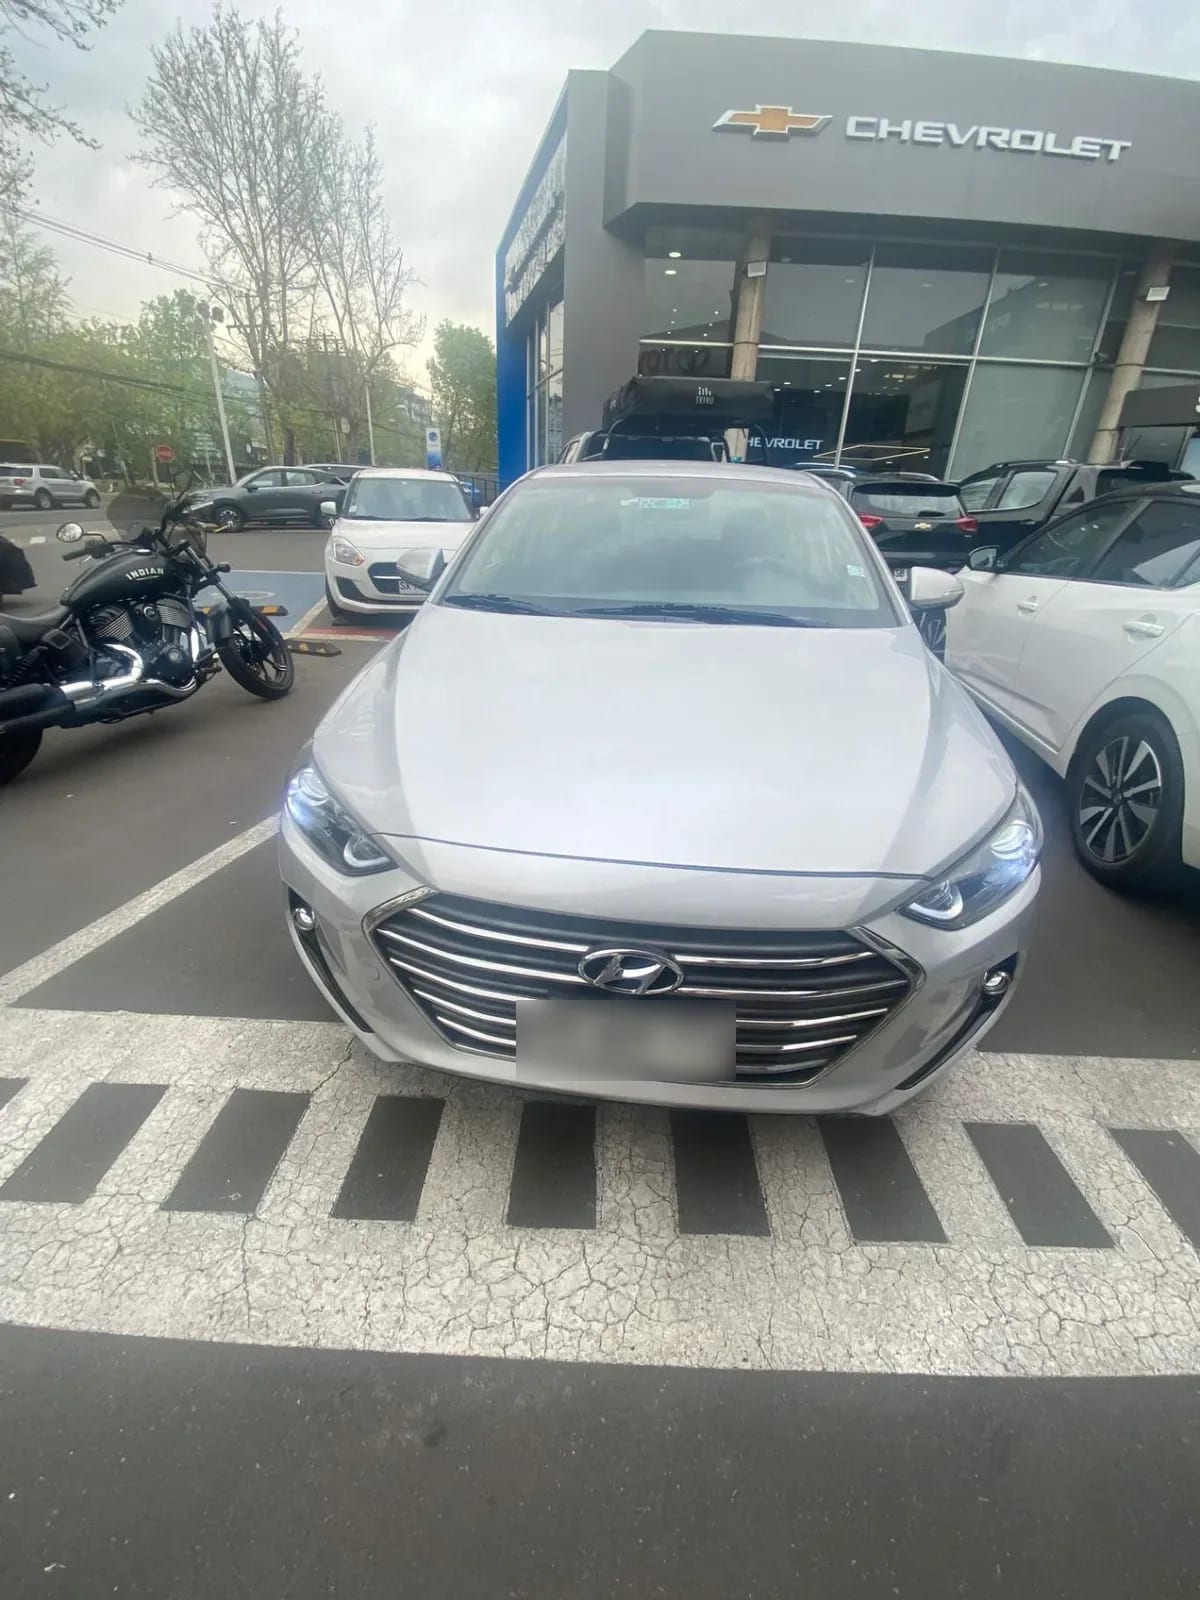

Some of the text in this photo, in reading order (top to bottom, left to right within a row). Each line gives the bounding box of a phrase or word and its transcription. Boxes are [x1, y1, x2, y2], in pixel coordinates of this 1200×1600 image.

[846, 115, 1132, 160] CHEVROLET
[747, 437, 823, 450] HEVROLET
[125, 567, 164, 580] INDIAN
